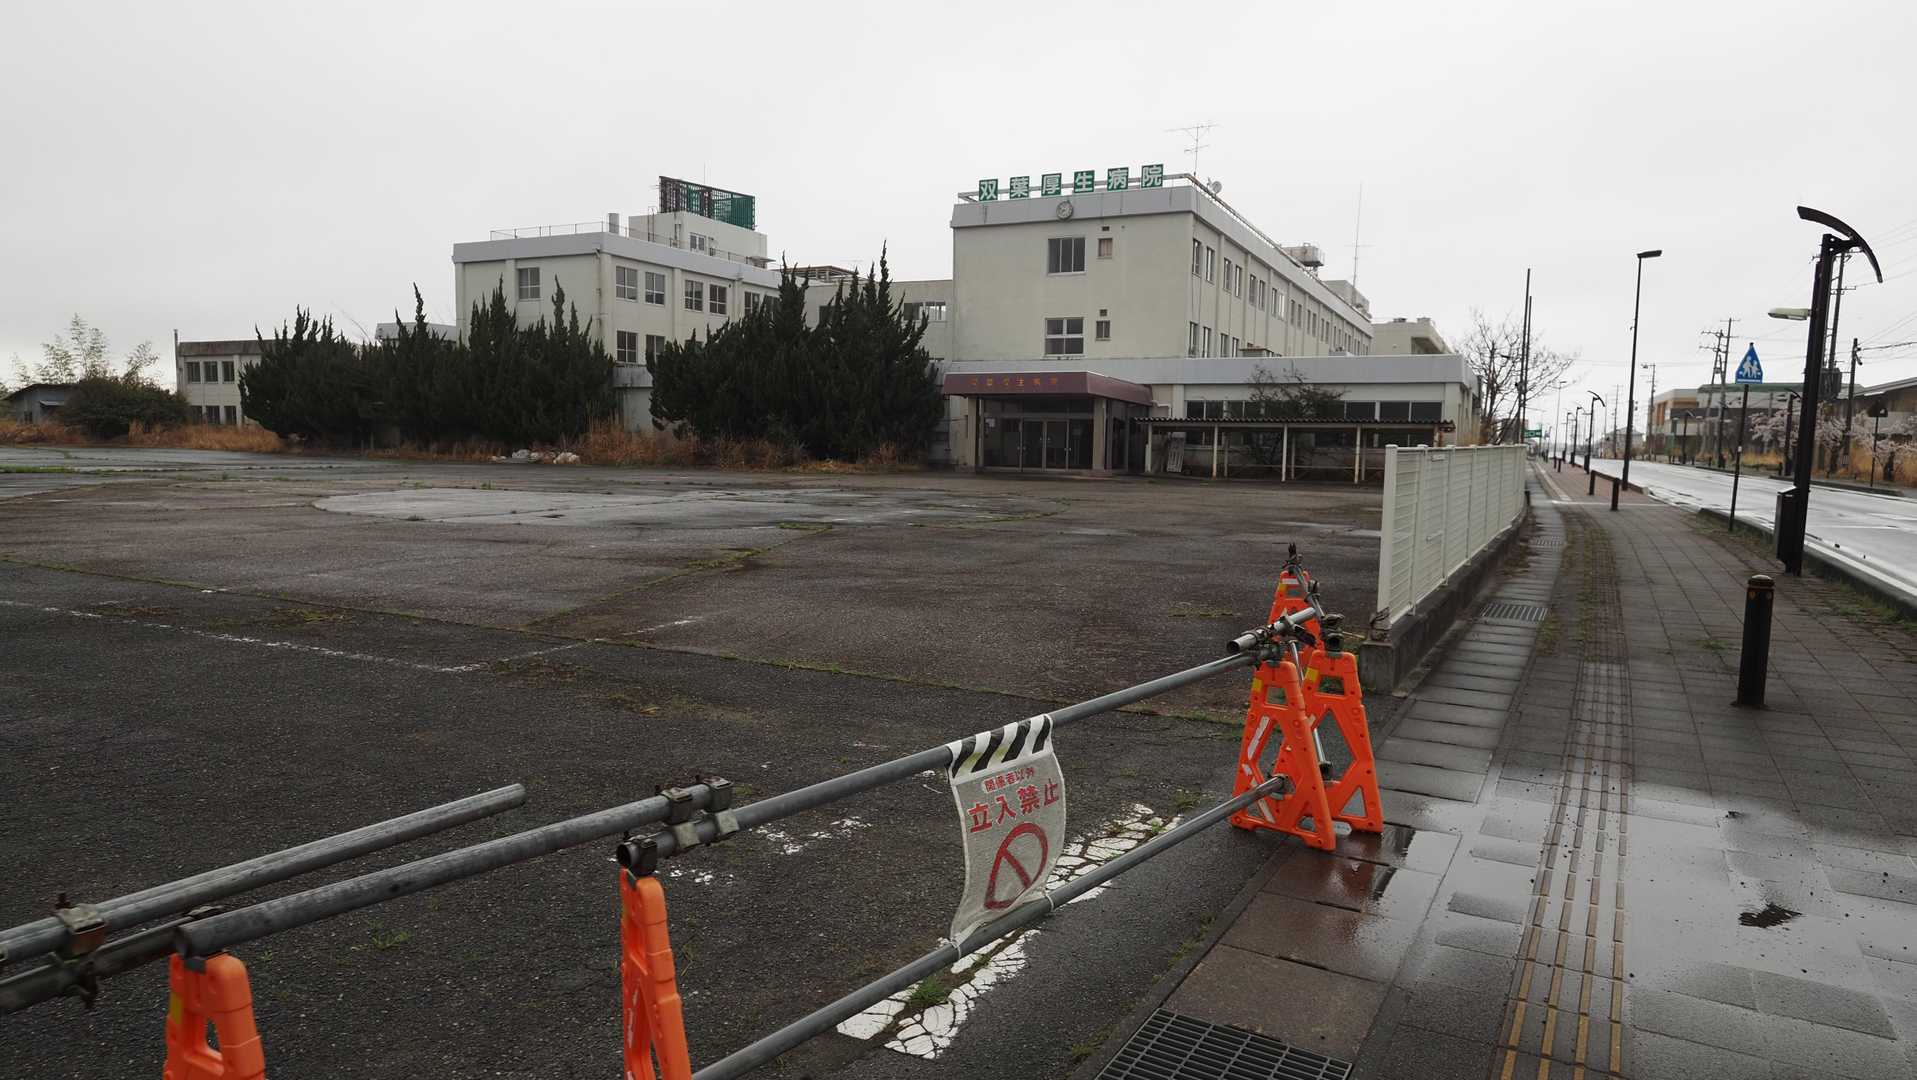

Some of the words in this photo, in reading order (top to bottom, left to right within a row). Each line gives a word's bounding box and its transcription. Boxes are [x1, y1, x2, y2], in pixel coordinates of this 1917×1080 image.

[979, 165, 1163, 201] 双葉厚生病院
[969, 778, 1059, 832] 立入禁止
